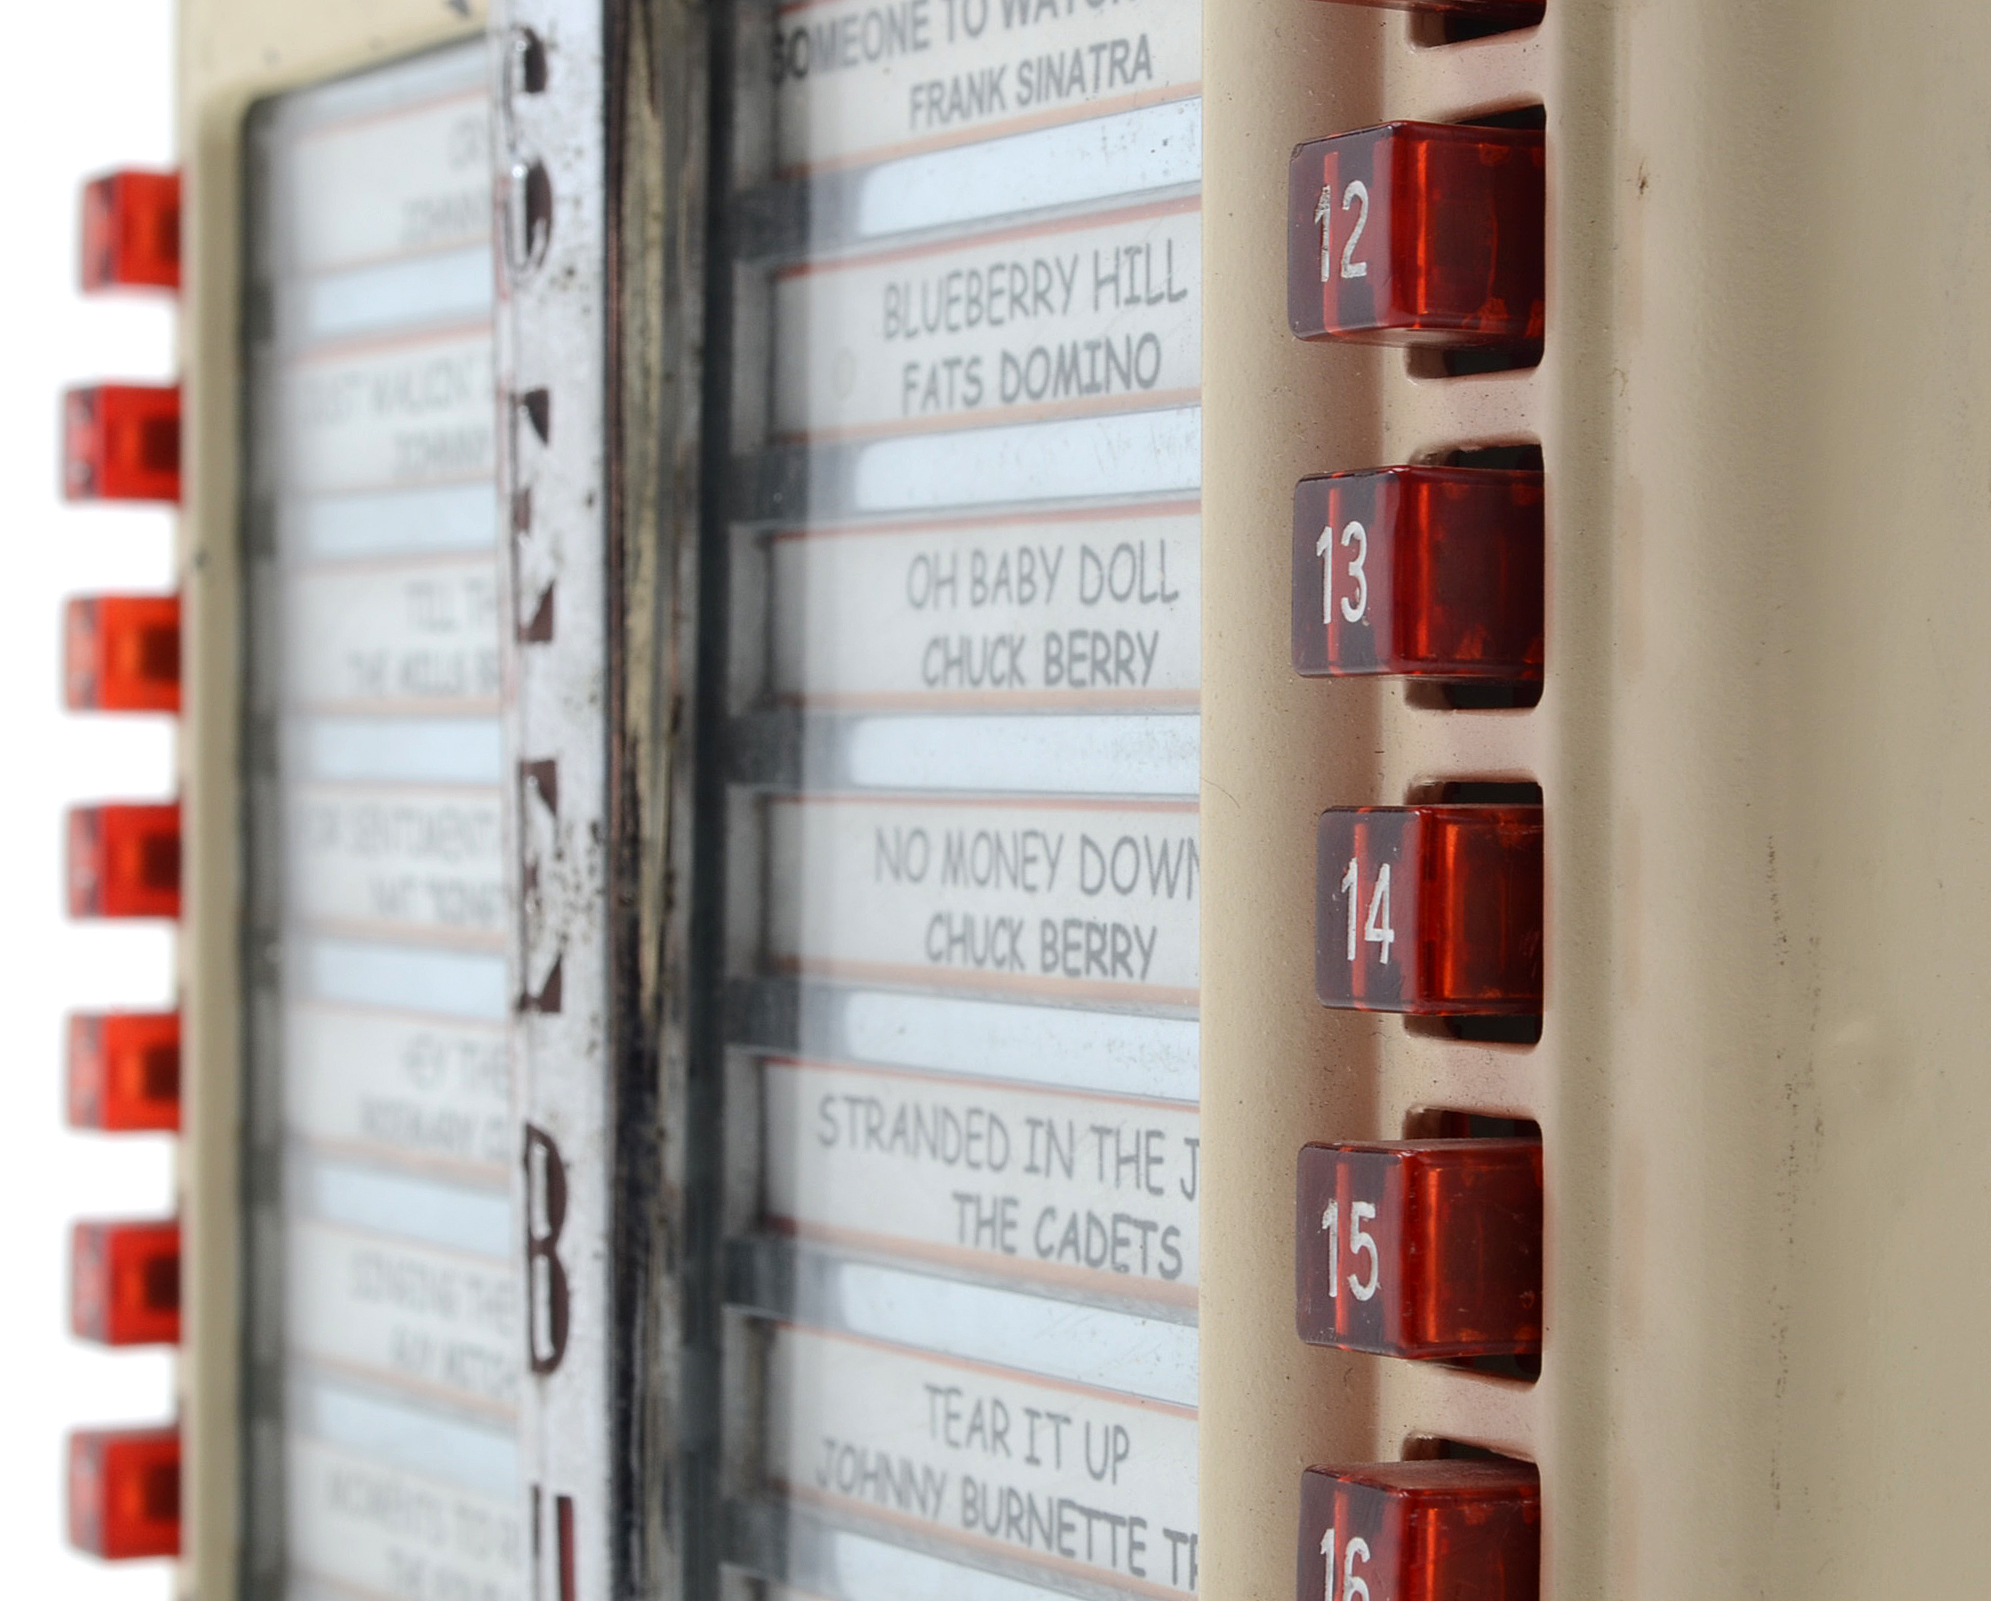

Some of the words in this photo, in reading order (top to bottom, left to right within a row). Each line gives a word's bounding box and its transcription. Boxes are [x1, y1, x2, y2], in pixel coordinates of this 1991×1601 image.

[909, 63, 1008, 130] FRANK
[1015, 33, 1154, 107] SINATRA
[1314, 180, 1369, 282] 12
[883, 253, 1079, 341] BLUEBERRY
[1093, 238, 1188, 312] HILL
[902, 356, 984, 416] FATS
[1000, 332, 1162, 405] DOMINO
[906, 552, 959, 610] OH
[969, 544, 1064, 607] BABY
[1079, 538, 1180, 607] DOLL
[1316, 520, 1367, 624] 13
[921, 634, 1026, 690] CHUCK
[1044, 629, 1160, 689] BERRY
[874, 827, 930, 885] NO
[941, 829, 1065, 893] MONEY
[925, 912, 1027, 972] CHUCK
[1040, 919, 1158, 981] BERRY
[1341, 857, 1395, 965] 14
[817, 1093, 1011, 1172] STRANDED
[1023, 1116, 1076, 1181] IN
[1090, 1124, 1166, 1197] THE
[951, 1192, 1019, 1255] THE
[1033, 1204, 1184, 1281] CADETS
[1321, 1198, 1380, 1301] 15
[923, 1382, 1011, 1459] TEAR
[1023, 1407, 1072, 1470] IT
[1085, 1421, 1130, 1485] UP
[815, 1438, 948, 1520] JOHNNY
[960, 1475, 1147, 1578] BURNETTE
[1320, 1528, 1371, 1601] 16
